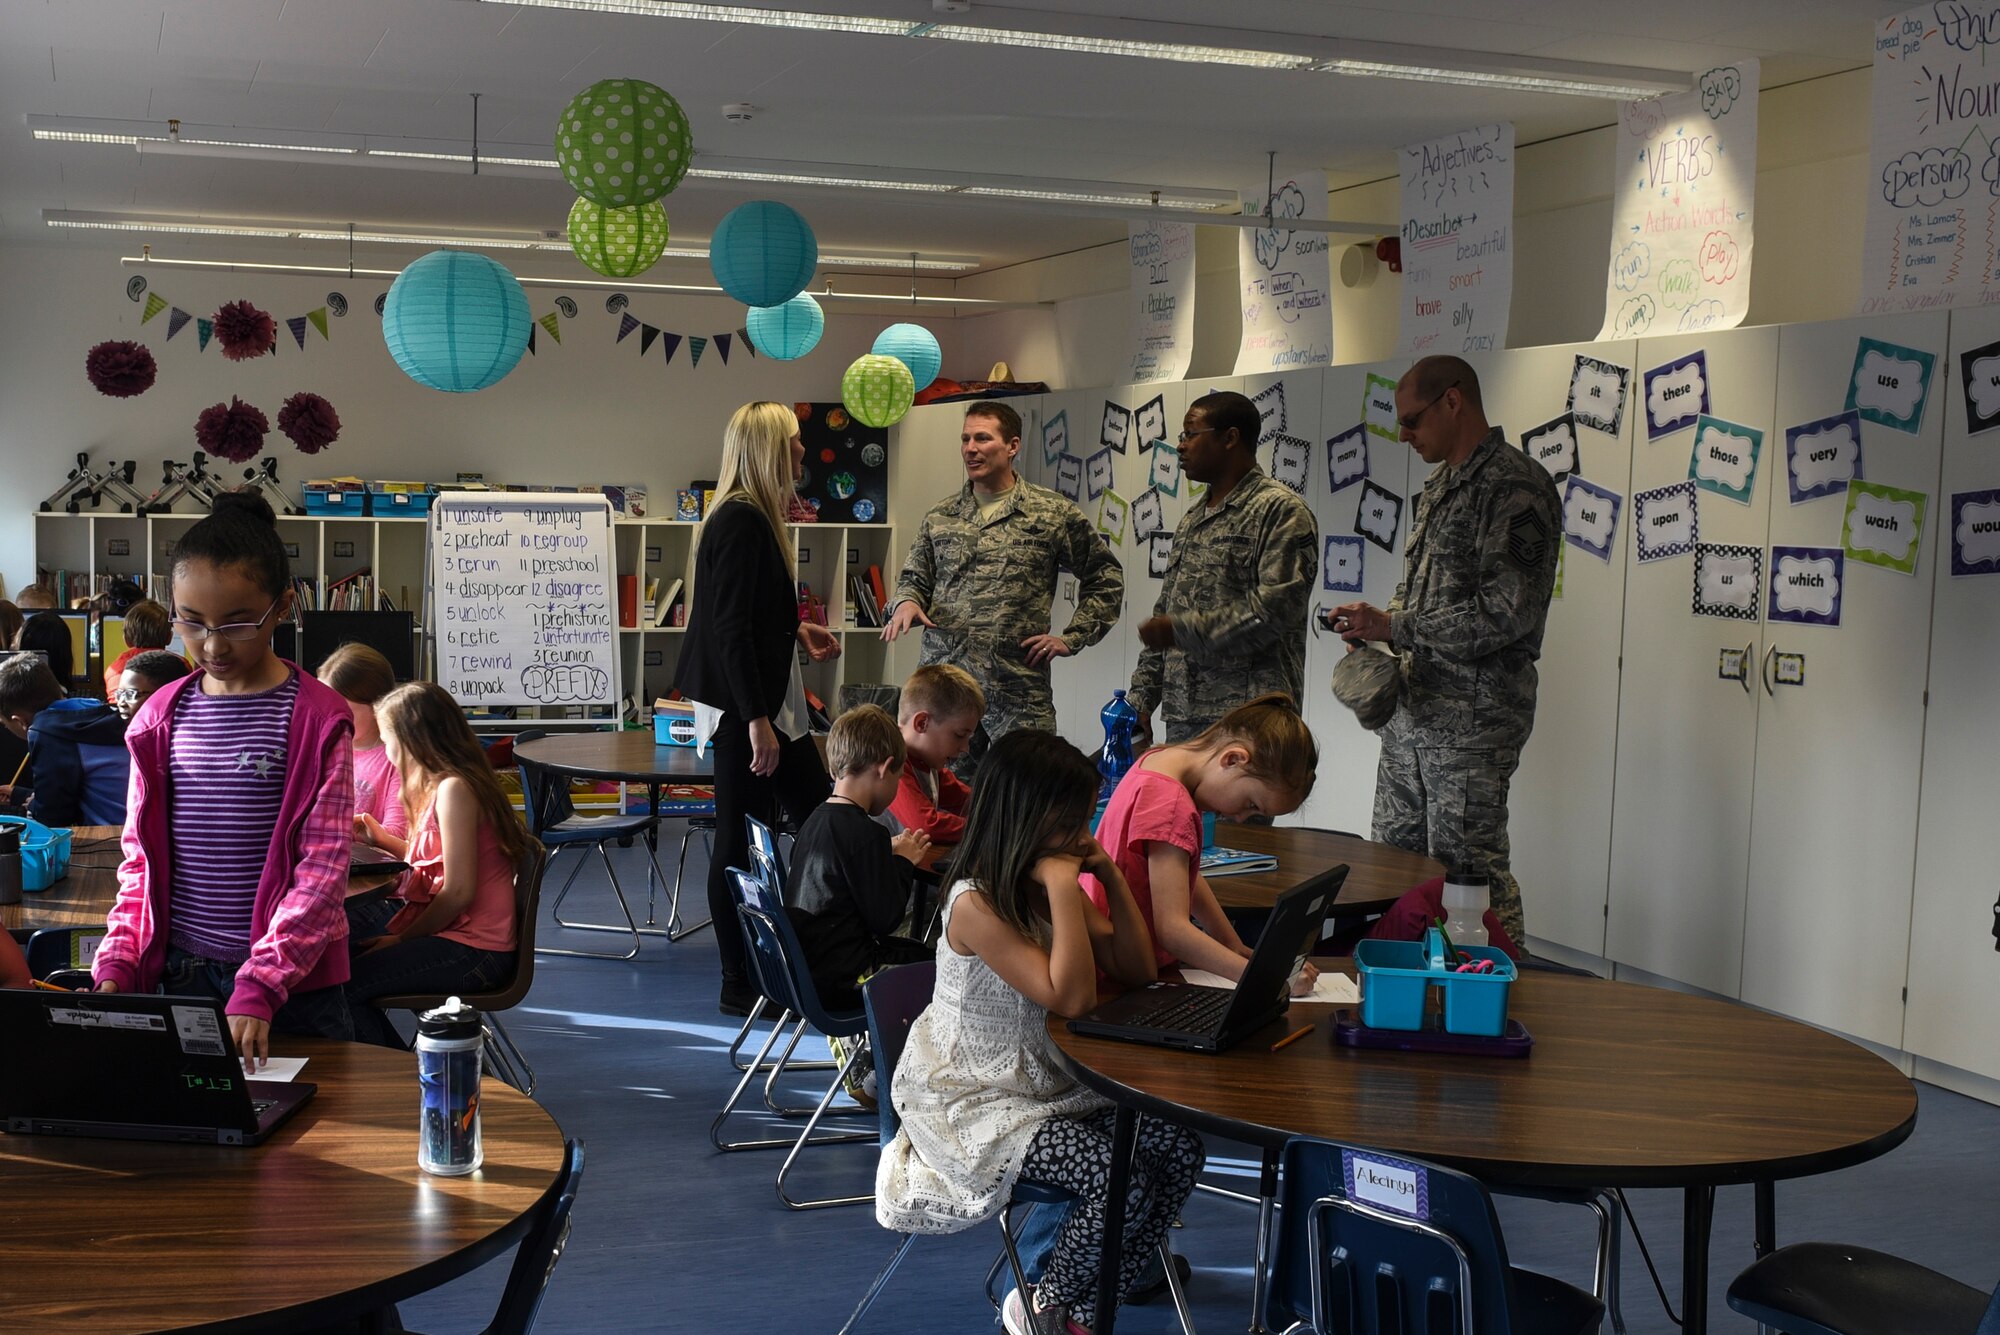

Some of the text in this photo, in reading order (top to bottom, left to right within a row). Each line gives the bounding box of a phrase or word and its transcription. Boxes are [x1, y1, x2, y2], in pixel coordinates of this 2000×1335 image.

[1903, 16, 1923, 37] dog
[1877, 35, 1900, 51] bread
[1903, 41, 1920, 61] pie
[1421, 136, 1494, 188] Adjectives
[1646, 135, 1714, 189] VERBS
[1892, 157, 1963, 202] person
[1645, 198, 1733, 235] Action Words
[1457, 226, 1507, 261] beautiful
[1449, 264, 1483, 291] smart
[1621, 256, 1642, 280] run
[1903, 274, 1917, 286] Eva
[1415, 296, 1442, 317] brave
[1452, 302, 1474, 334] silly
[1877, 373, 1899, 389] use
[1590, 384, 1602, 398] sit
[1662, 383, 1692, 402] these
[1372, 398, 1393, 413] made
[1337, 447, 1358, 464] many
[1539, 442, 1563, 460] sleep
[1709, 445, 1739, 466] those
[1810, 446, 1838, 463] very
[1159, 462, 1171, 475] cold
[1283, 455, 1298, 469] goes
[454, 506, 503, 523] unsafe
[537, 506, 582, 530] unplug
[1372, 508, 1383, 521] off
[1580, 507, 1597, 525] tell
[1652, 512, 1680, 528] upon
[1864, 513, 1899, 532] wash
[455, 528, 513, 552] preheat
[534, 534, 588, 553] regroup
[458, 557, 501, 572] rerun
[532, 554, 599, 578] preschool
[1339, 557, 1347, 567] or
[1721, 574, 1734, 585] us
[1788, 572, 1825, 588] which
[460, 577, 529, 602] disappear
[545, 578, 604, 602] disagree
[458, 602, 506, 620] unlock
[542, 608, 610, 632] prehistoric
[461, 627, 500, 645] retie
[543, 627, 610, 645] unfortunate
[461, 652, 512, 670] rewind
[543, 649, 594, 664] reunion
[461, 676, 507, 700] unpack
[530, 669, 600, 696] PREFIX
[1357, 1167, 1415, 1195] Alecinya
